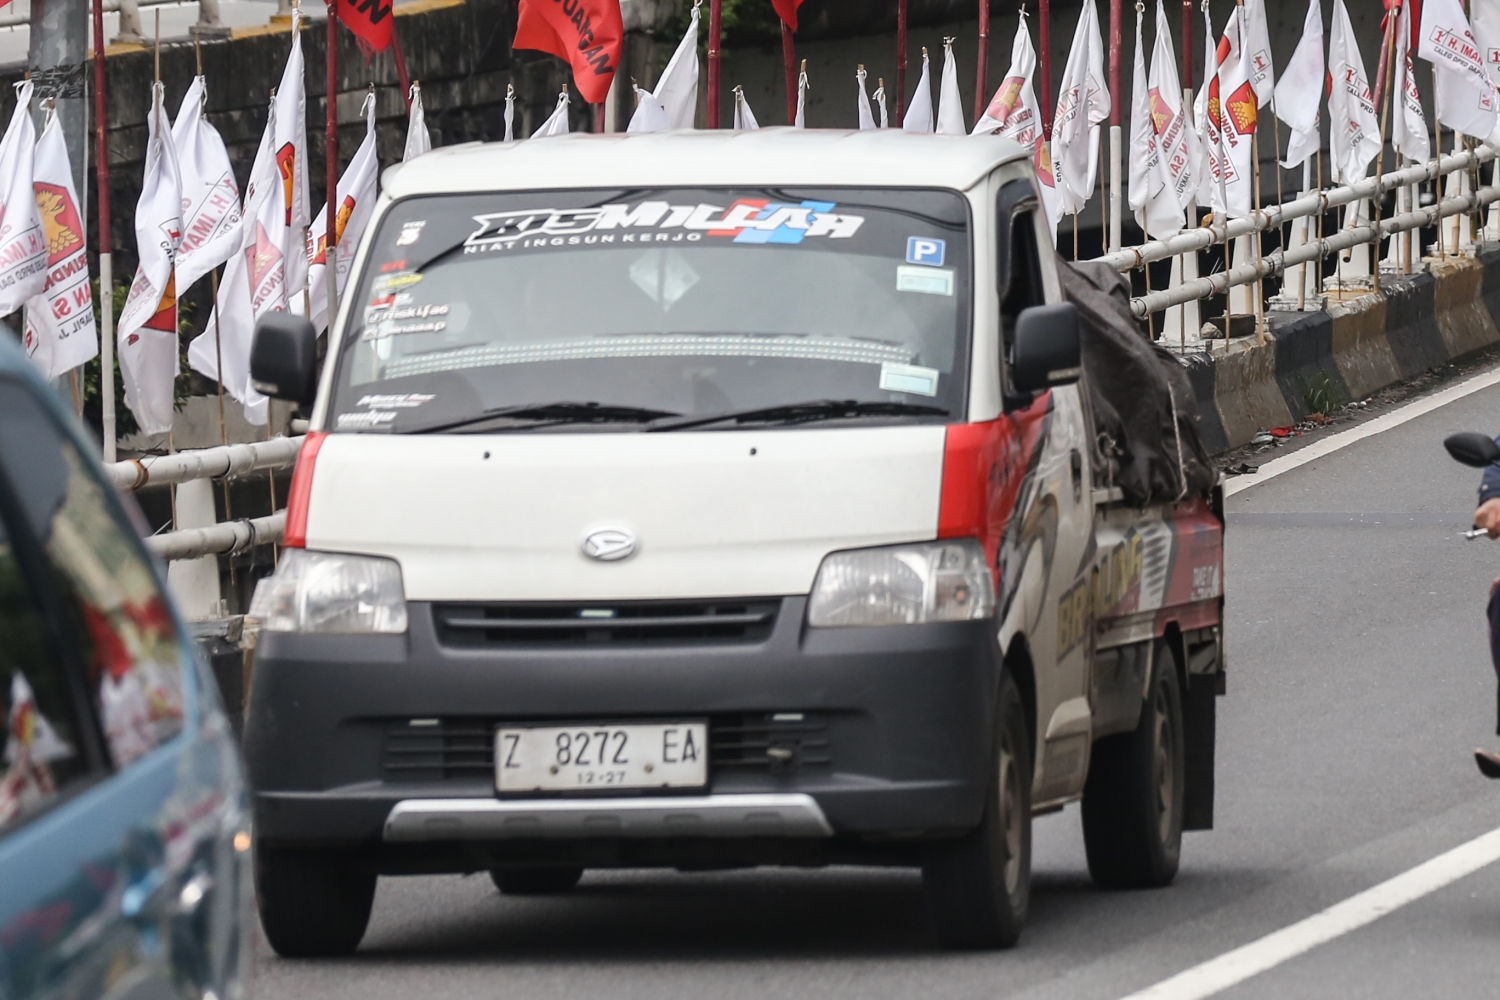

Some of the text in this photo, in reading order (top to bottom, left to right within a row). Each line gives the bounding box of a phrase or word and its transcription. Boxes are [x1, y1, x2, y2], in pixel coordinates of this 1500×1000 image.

[464, 231, 703, 255] NIAT INGSUN KERJO
[914, 240, 939, 261] P
[503, 728, 698, 769] Z 8272 EA
